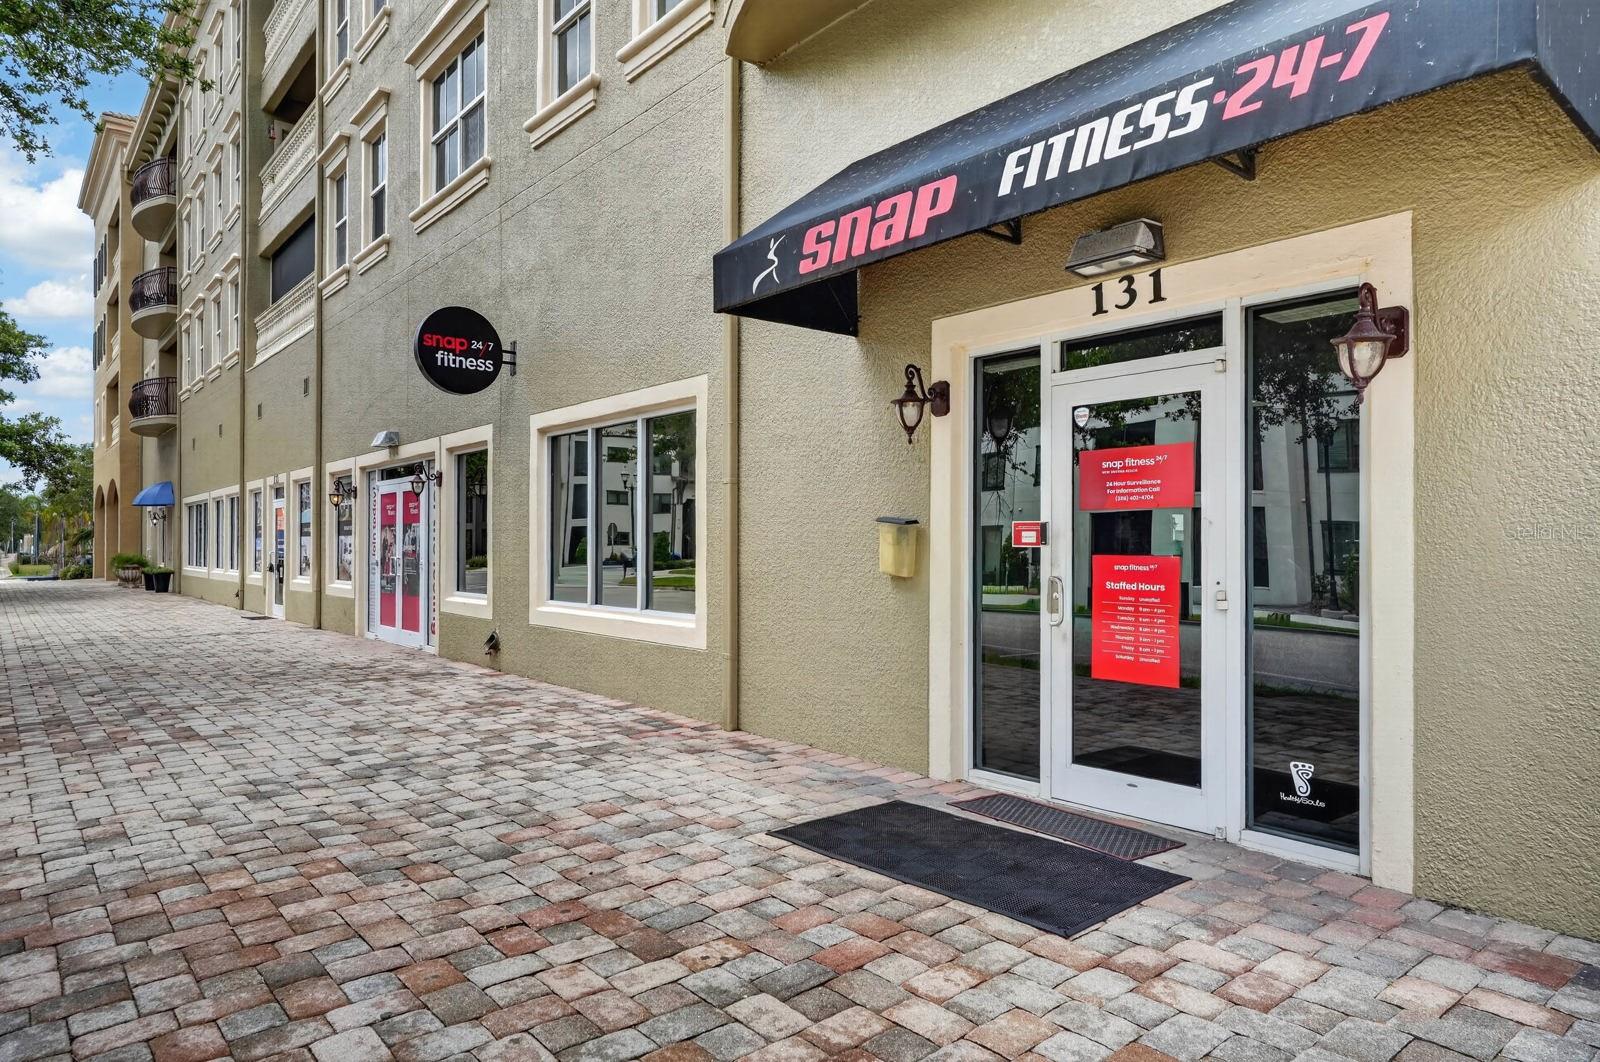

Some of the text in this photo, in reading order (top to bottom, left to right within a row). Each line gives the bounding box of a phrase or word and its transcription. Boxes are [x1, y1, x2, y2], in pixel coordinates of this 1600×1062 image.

[799, 174, 958, 275] snap
[998, 77, 1214, 197] FITNESS
[1091, 268, 1167, 316] 131
[423, 333, 494, 357] snap 24/7
[435, 350, 494, 372] fitness
[1102, 460, 1123, 469] snap
[1125, 457, 1155, 467] fitness
[1105, 581, 1166, 591] Staffed Hours
